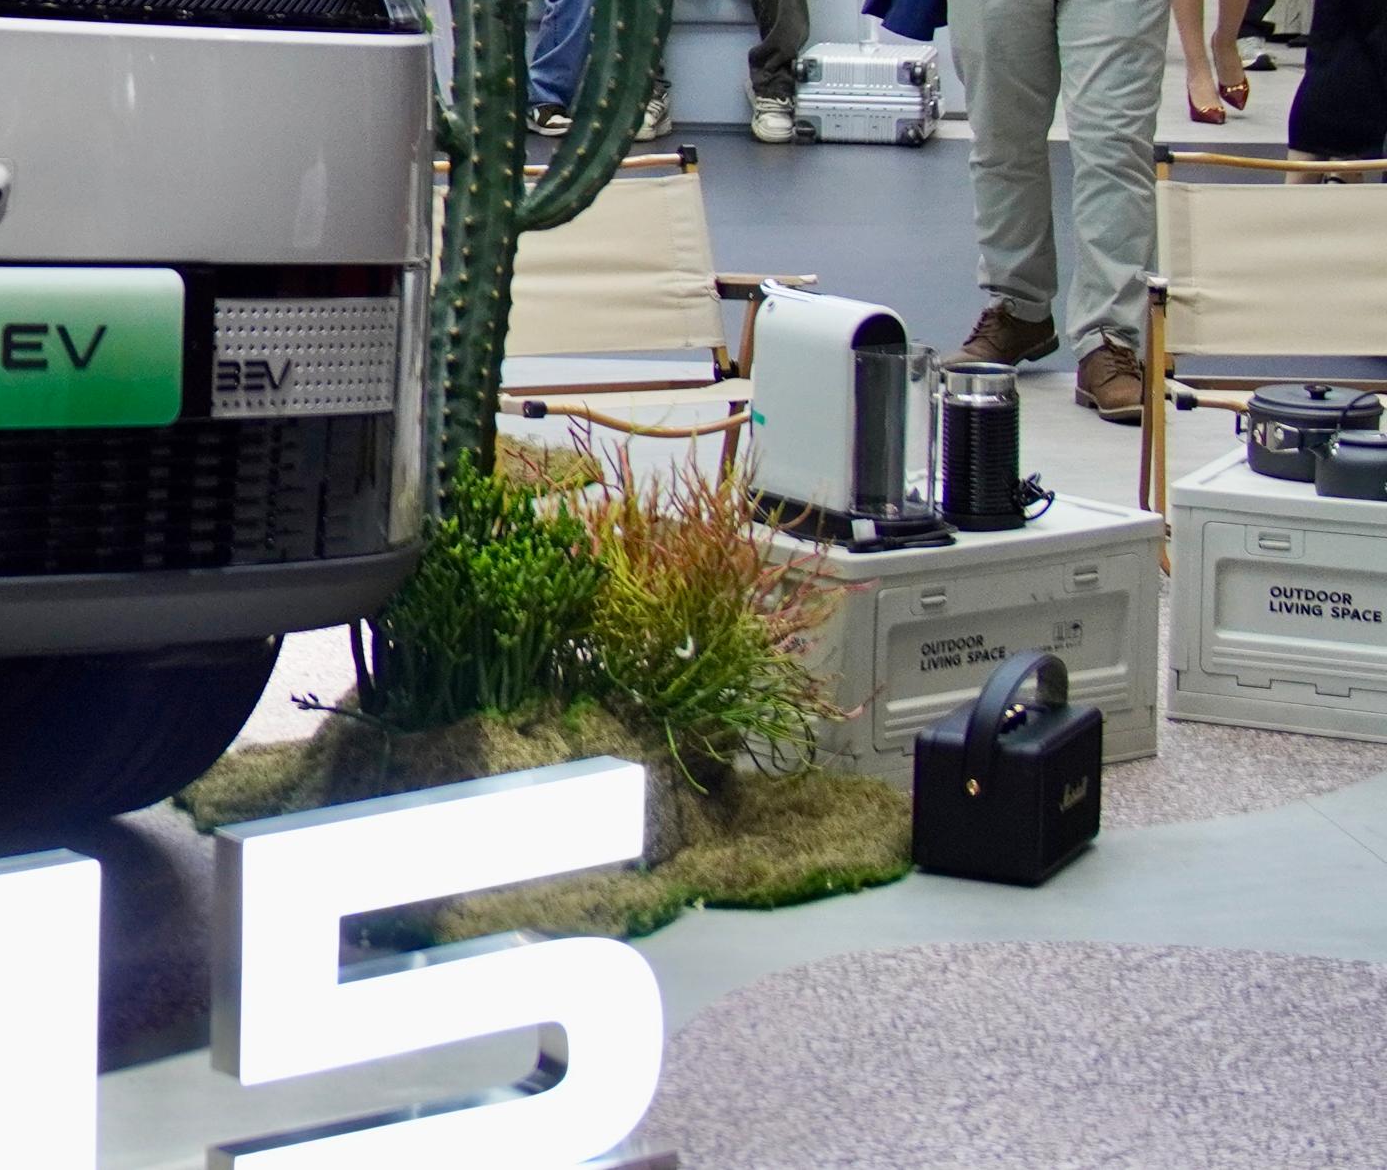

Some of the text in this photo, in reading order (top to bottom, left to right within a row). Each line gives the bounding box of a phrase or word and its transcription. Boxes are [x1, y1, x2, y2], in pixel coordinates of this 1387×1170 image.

[1, 322, 107, 370] EV
[1270, 586, 1353, 605] OUTDOOR
[1269, 600, 1382, 623] LIVING SPACE
[921, 634, 985, 657] OUTDOOR
[920, 645, 1007, 671] LIVING SPACE
